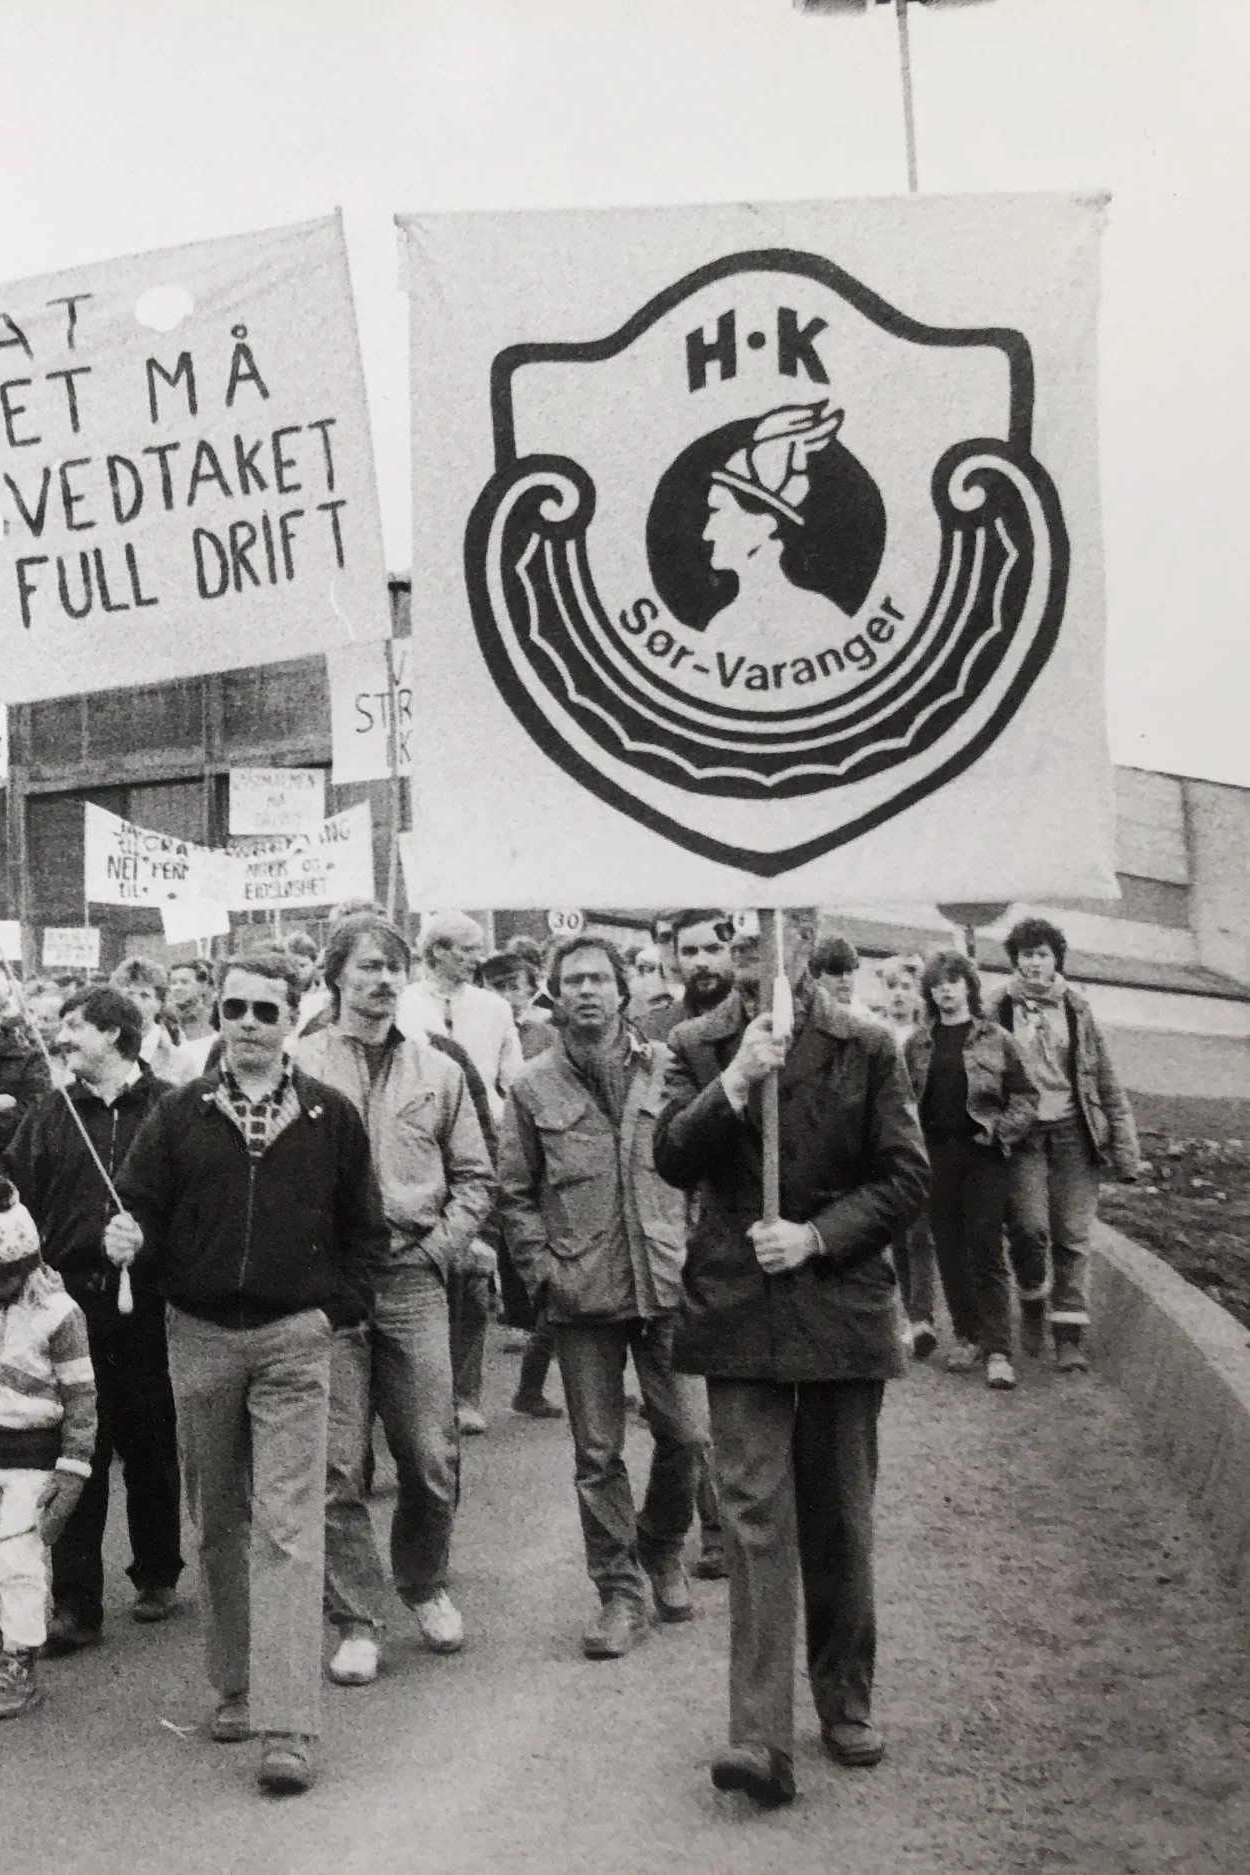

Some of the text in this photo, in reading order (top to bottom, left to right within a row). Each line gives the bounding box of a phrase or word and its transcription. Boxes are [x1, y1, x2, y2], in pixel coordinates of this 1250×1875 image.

[146, 323, 269, 424] MÅ
[4, 417, 338, 539] VEDTAKET
[15, 542, 158, 630] FULL
[192, 499, 347, 601] DRIFT
[618, 594, 906, 692] Sør-Varanger
[553, 911, 580, 930] 30
